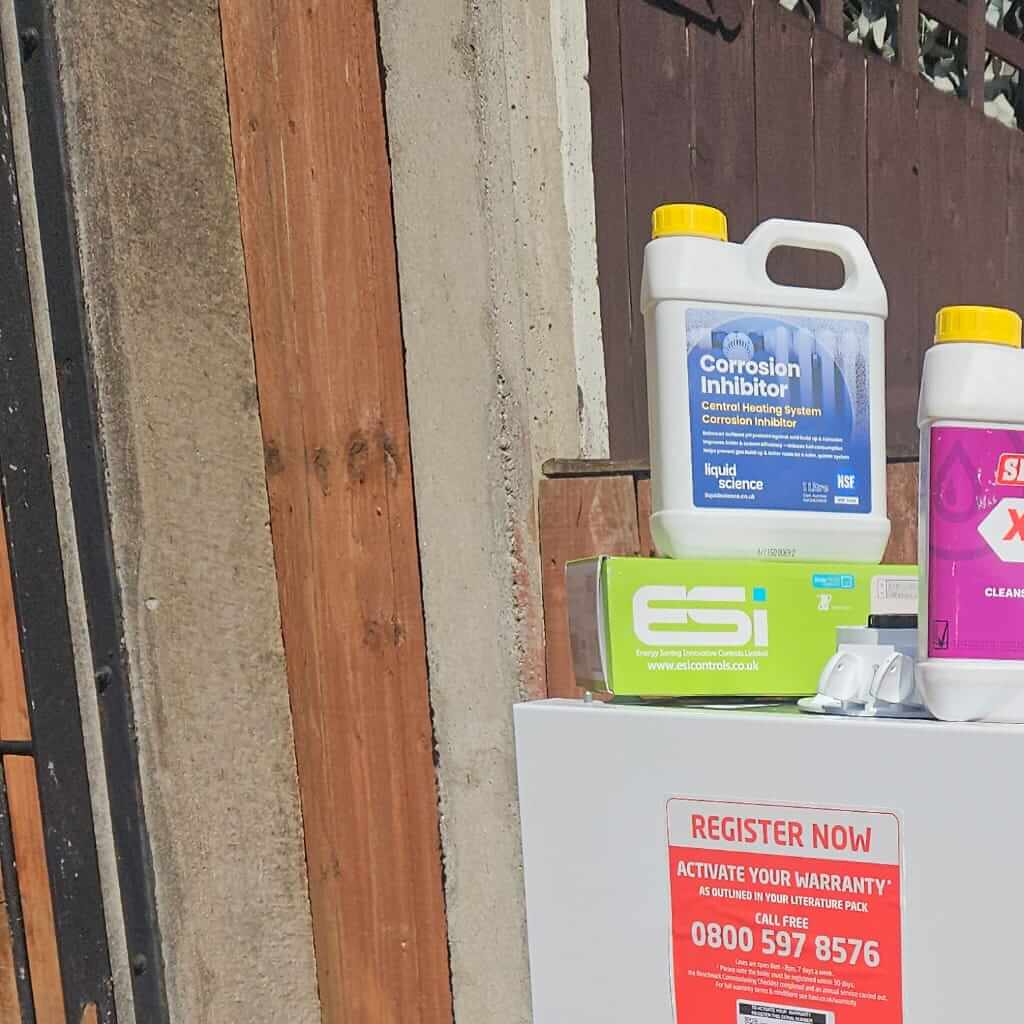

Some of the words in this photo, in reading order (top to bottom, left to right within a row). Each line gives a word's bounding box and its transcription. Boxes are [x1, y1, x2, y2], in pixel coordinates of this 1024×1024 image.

[700, 355, 800, 377] Corrosion
[701, 376, 789, 398] Inhibitor
[702, 401, 740, 412] Central
[742, 403, 782, 417] Heating
[784, 405, 822, 418] System
[702, 415, 752, 426] Corrosion
[754, 416, 796, 428] Inhibitor
[704, 463, 736, 478] liquid
[718, 477, 764, 490] science
[837, 474, 856, 489] NSF
[648, 660, 759, 671] www.esicontrols.co.uk
[691, 814, 804, 847] REGISTER
[812, 823, 872, 852] NOW
[676, 860, 745, 882] ACTIVATE
[749, 866, 791, 886] YOUR
[699, 886, 710, 896] AS
[712, 887, 752, 900] OUTLINED
[754, 890, 763, 901] IN
[765, 892, 788, 904] YOUR
[790, 895, 843, 910] LITERATURE
[845, 900, 869, 912] PACK
[755, 912, 780, 926] CALL
[783, 915, 809, 929] FREE
[691, 921, 754, 951] 0800
[761, 928, 806, 958] 597
[815, 935, 881, 968] 8576
